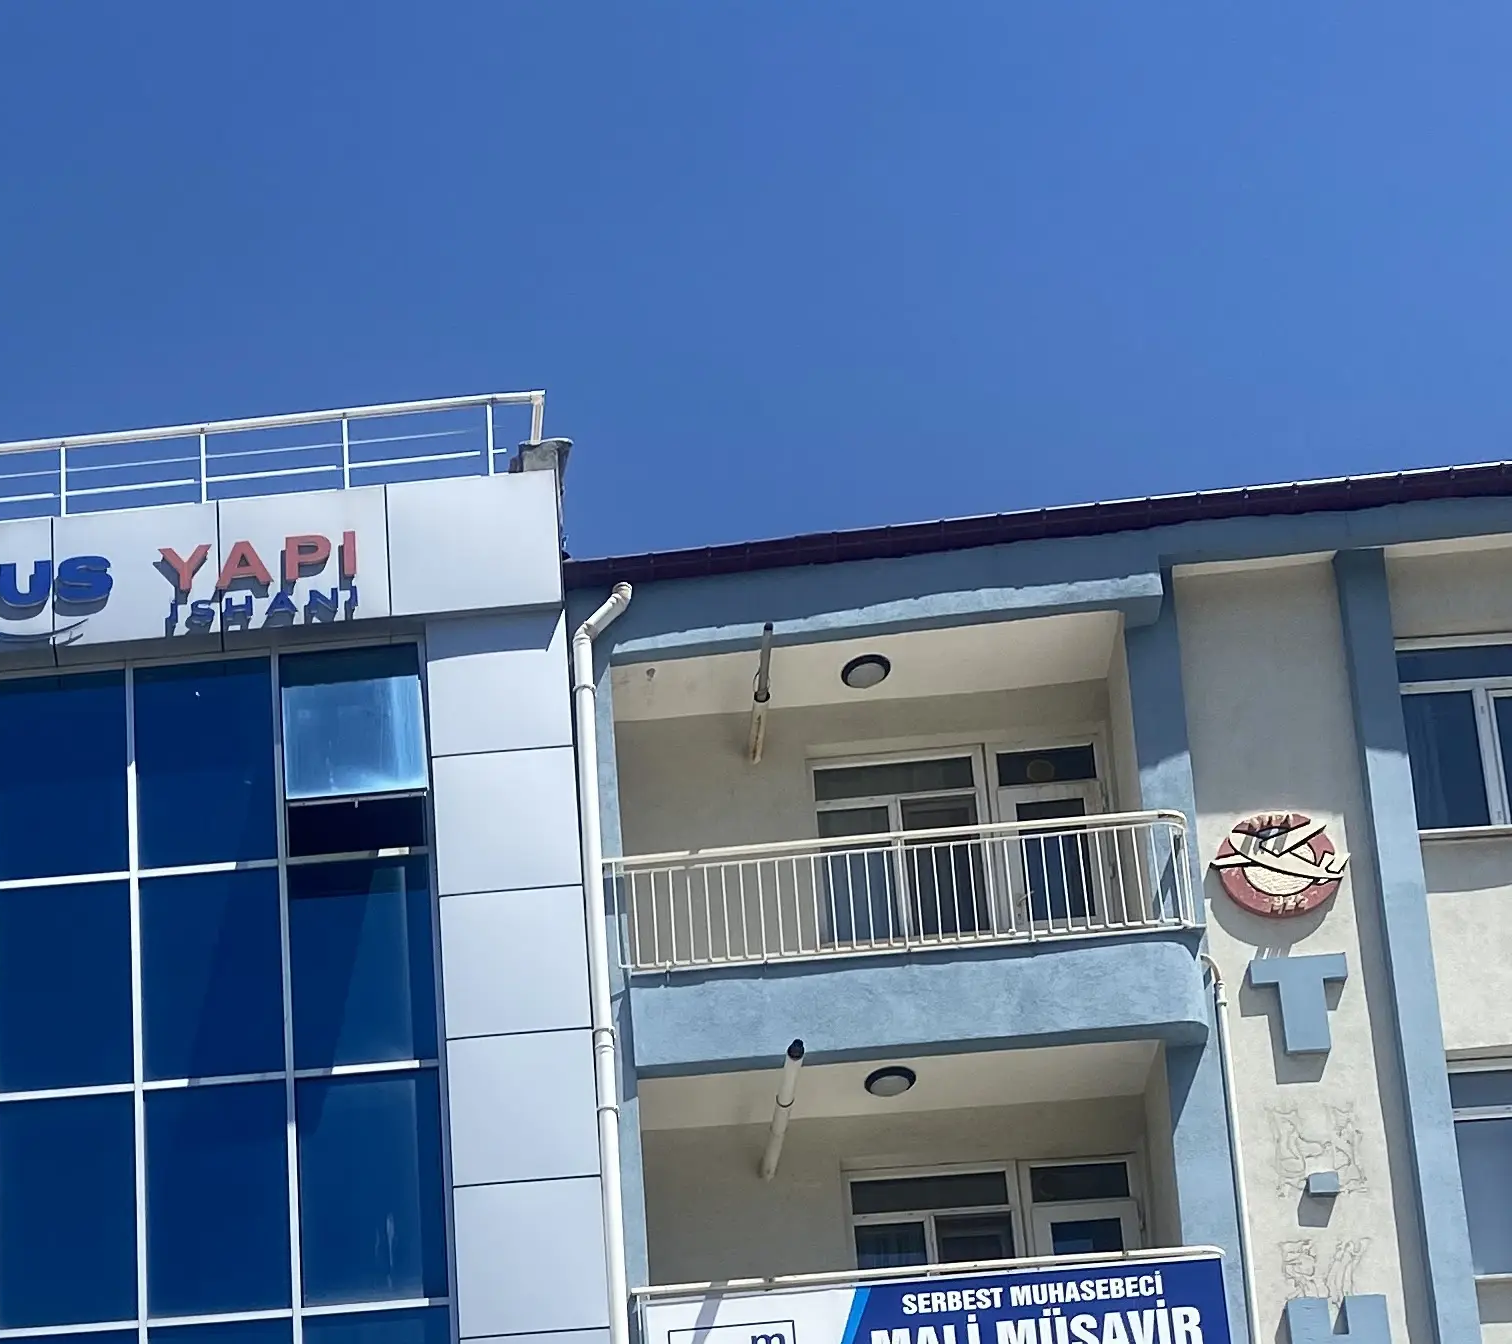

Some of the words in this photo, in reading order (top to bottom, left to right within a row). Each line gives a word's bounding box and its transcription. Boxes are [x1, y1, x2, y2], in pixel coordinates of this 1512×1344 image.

[158, 530, 357, 591] YAPI
[901, 1287, 1003, 1316] SERBEST
[1010, 1270, 1164, 1306] MUHASEBECİ
